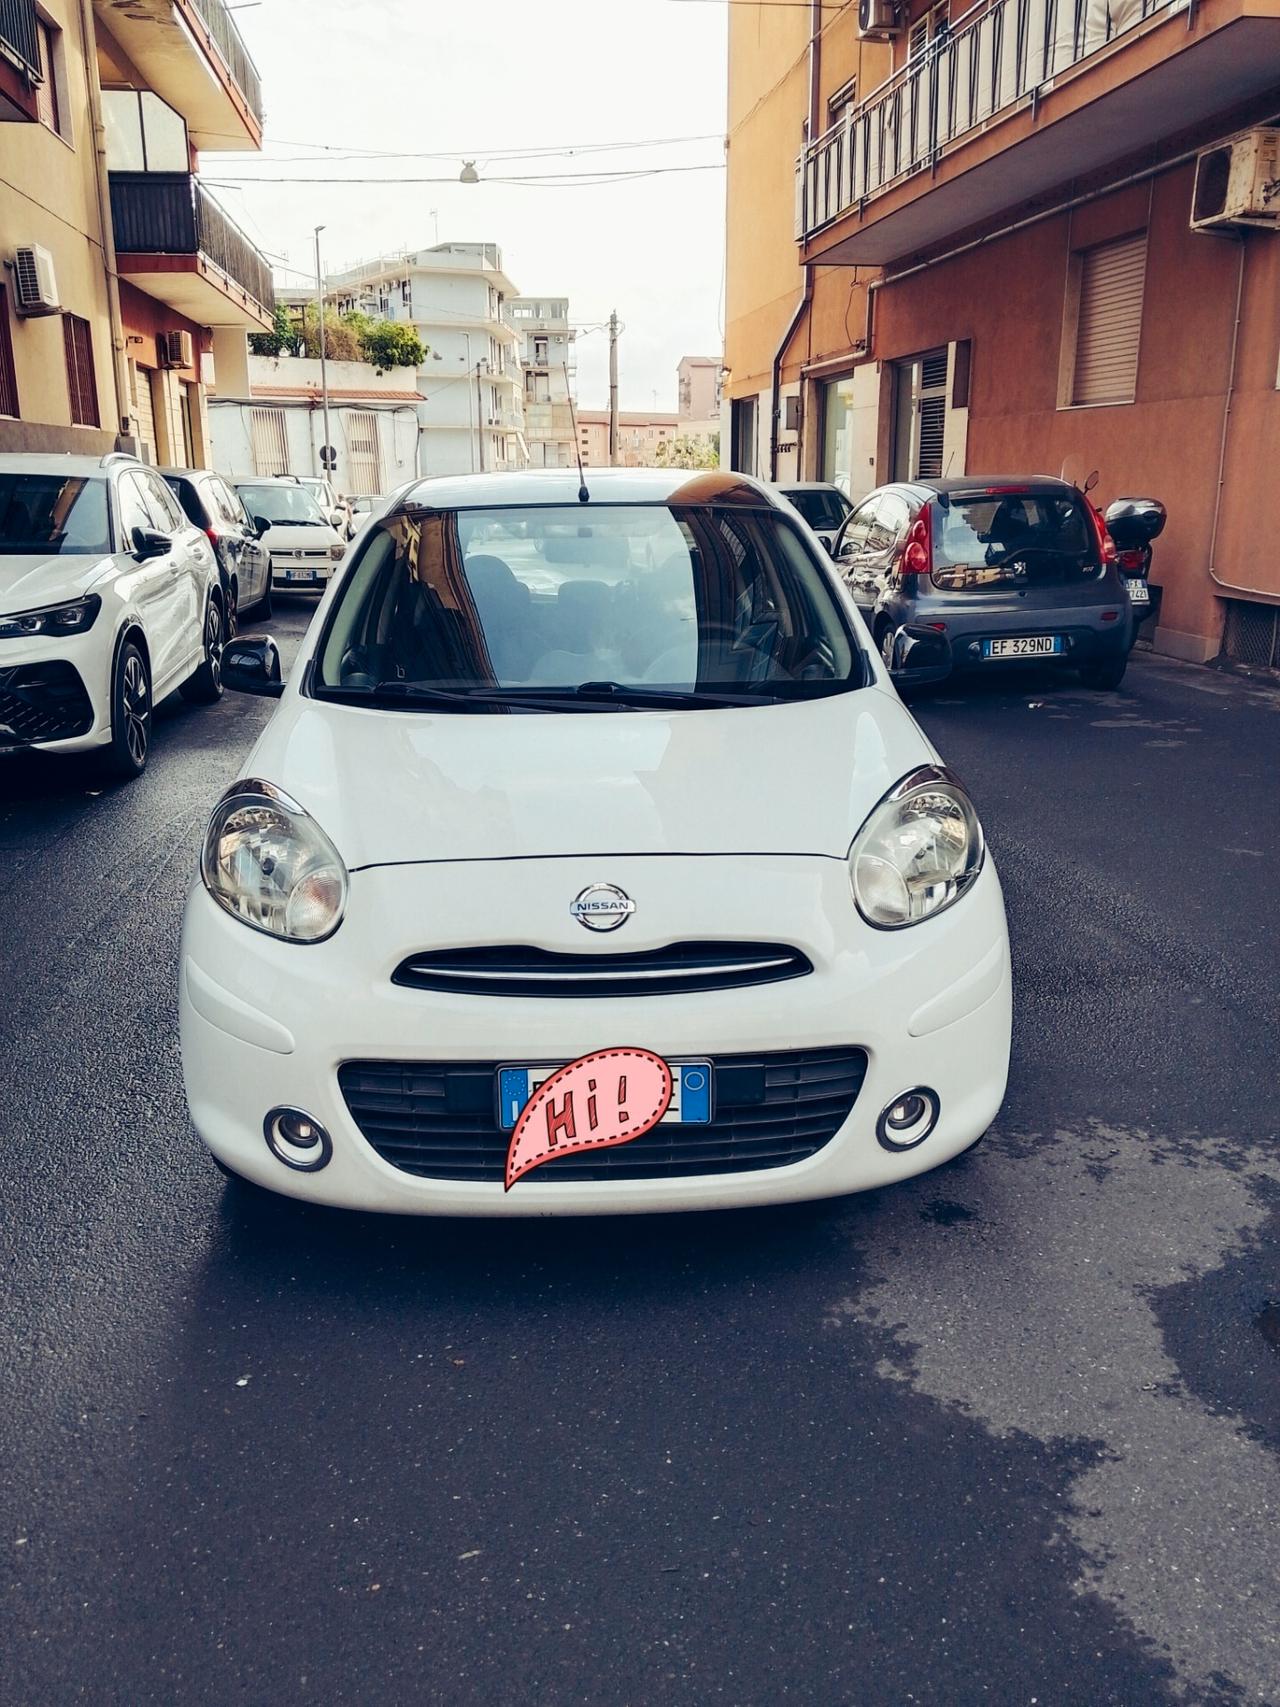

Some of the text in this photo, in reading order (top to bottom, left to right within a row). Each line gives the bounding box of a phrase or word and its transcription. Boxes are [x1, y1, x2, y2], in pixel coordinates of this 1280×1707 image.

[1130, 590, 1148, 599] 7421
[992, 641, 1007, 655] EF
[1012, 638, 1052, 654] 329ND
[577, 902, 628, 911] NISSAN
